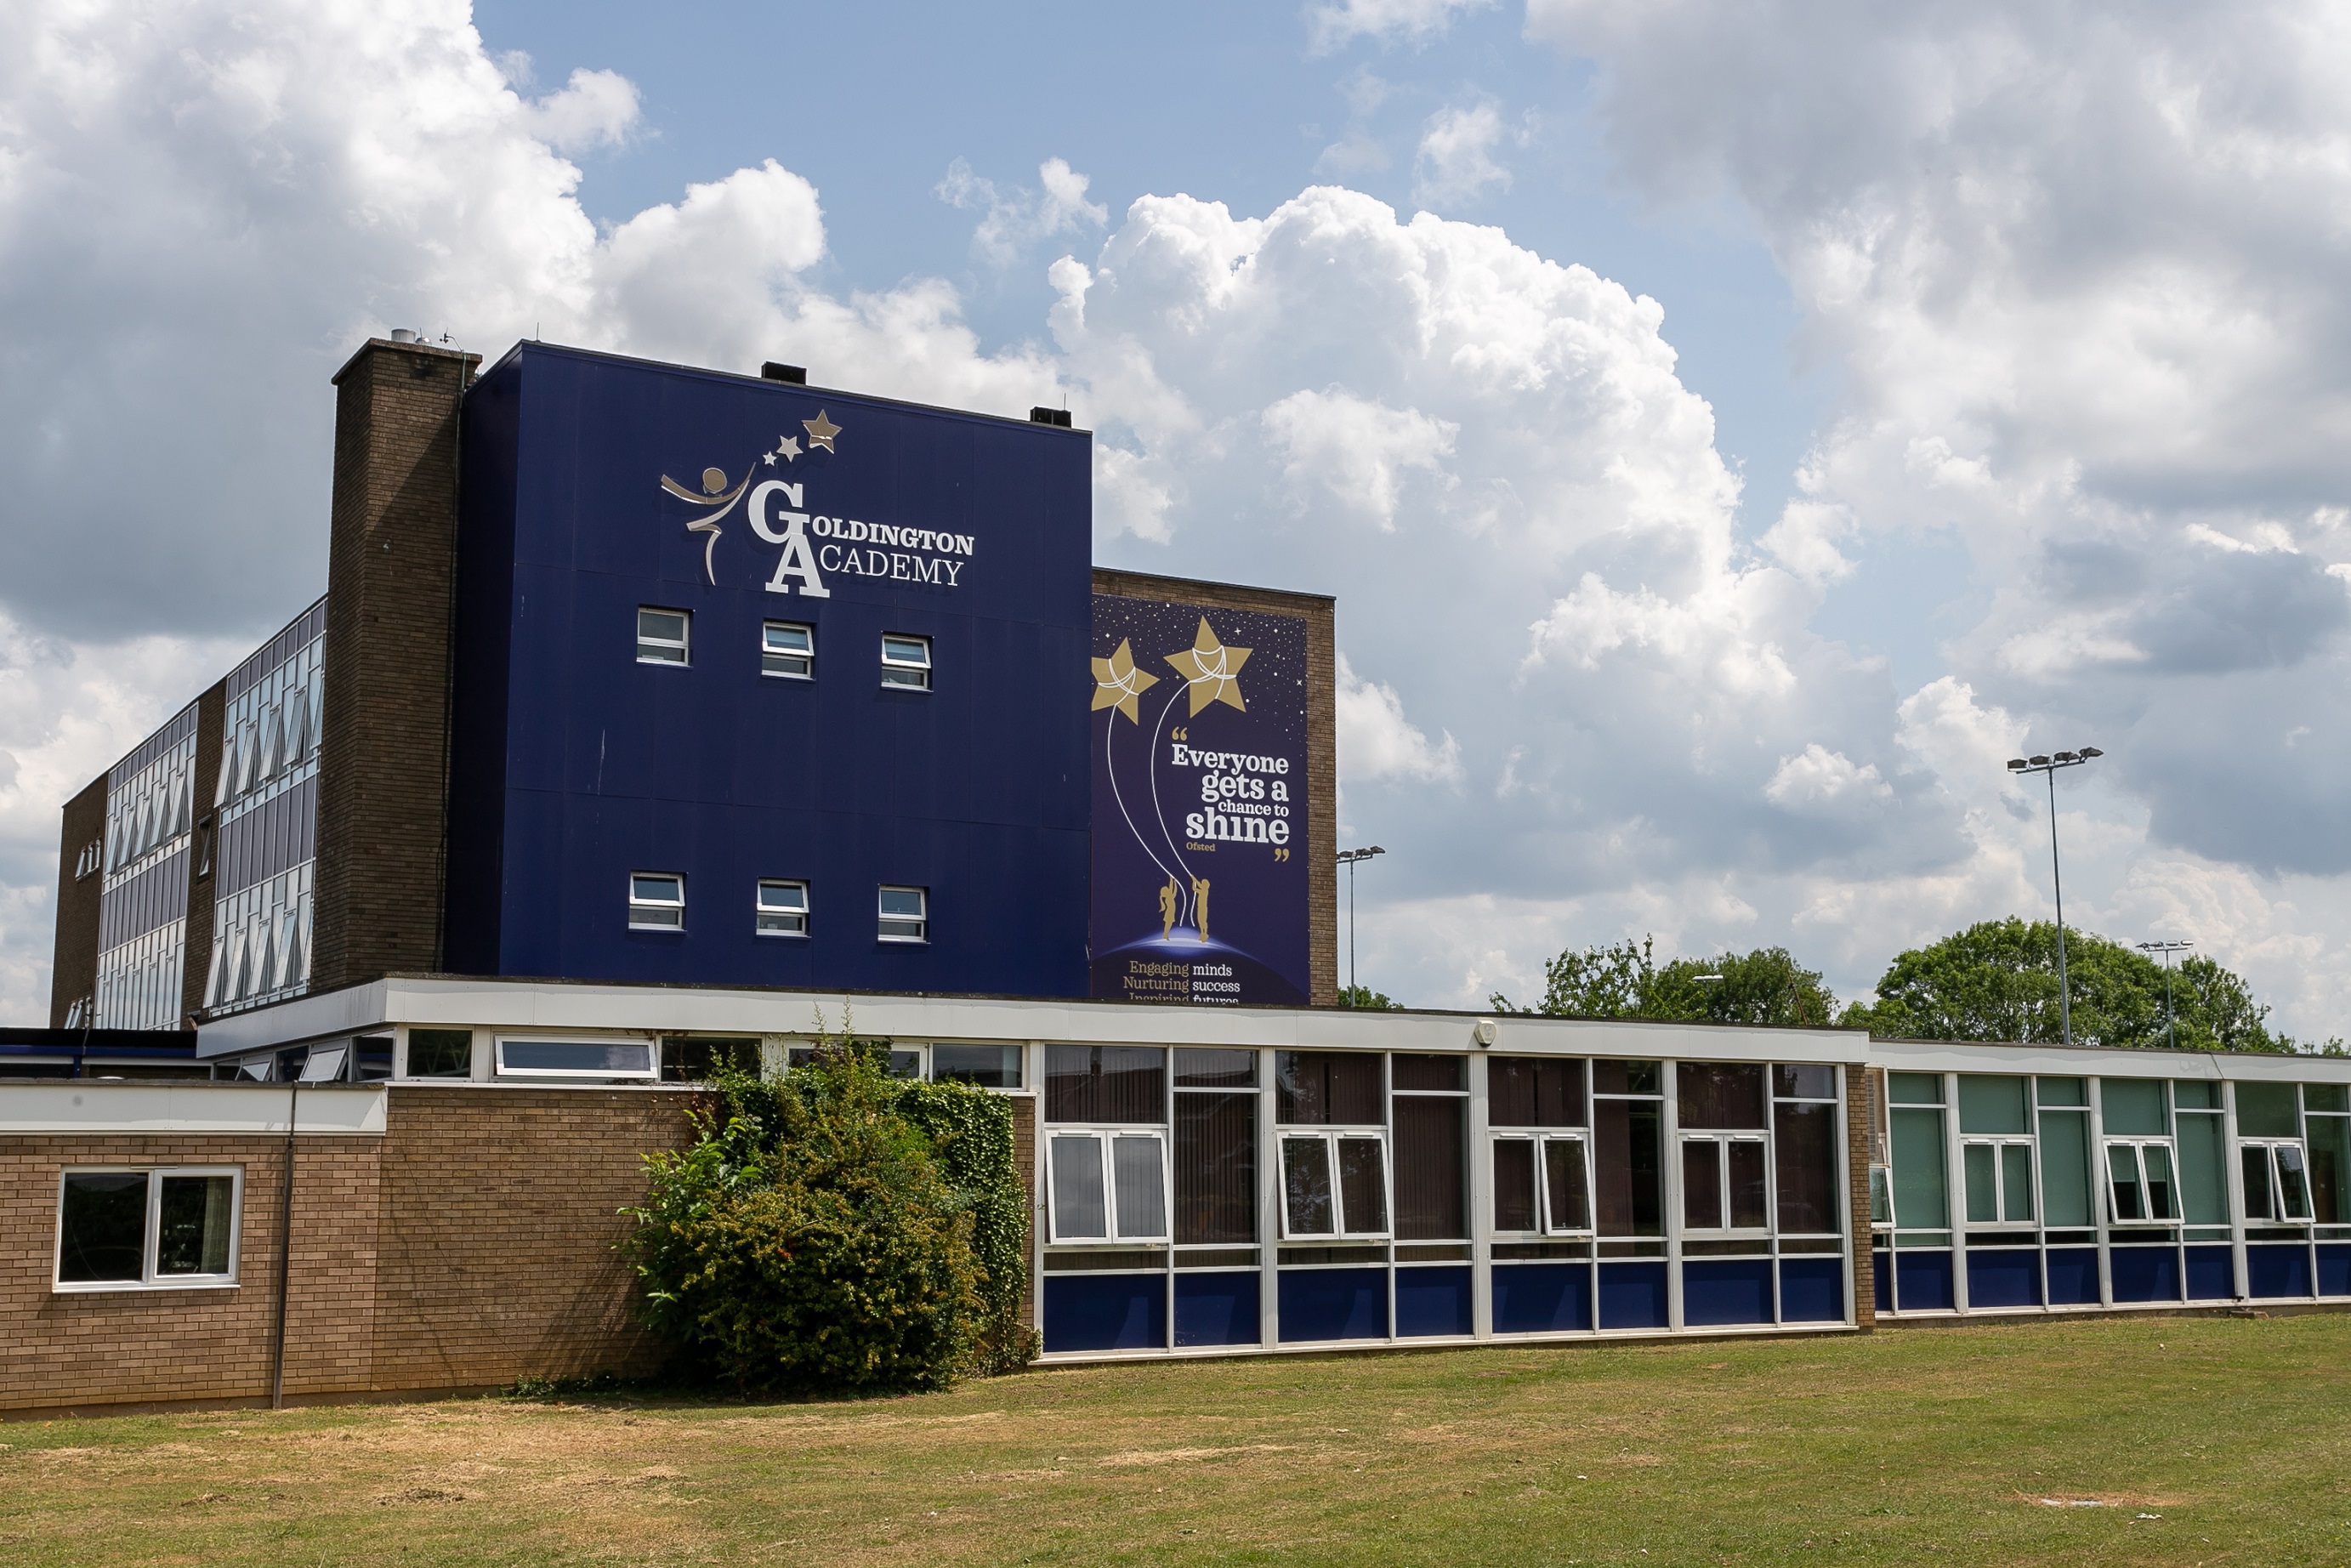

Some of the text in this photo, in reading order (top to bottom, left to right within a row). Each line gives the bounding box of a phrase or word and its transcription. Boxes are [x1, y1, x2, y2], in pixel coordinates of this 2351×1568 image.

[1172, 743, 1289, 775] Everyone
[1201, 770, 1289, 803] gets a
[1218, 799, 1290, 817] chance to
[1186, 806, 1290, 844] shine
[1186, 841, 1216, 851] Ofsted
[1129, 960, 1233, 978] Engaging minds
[1123, 976, 1241, 993] Nurturing success
